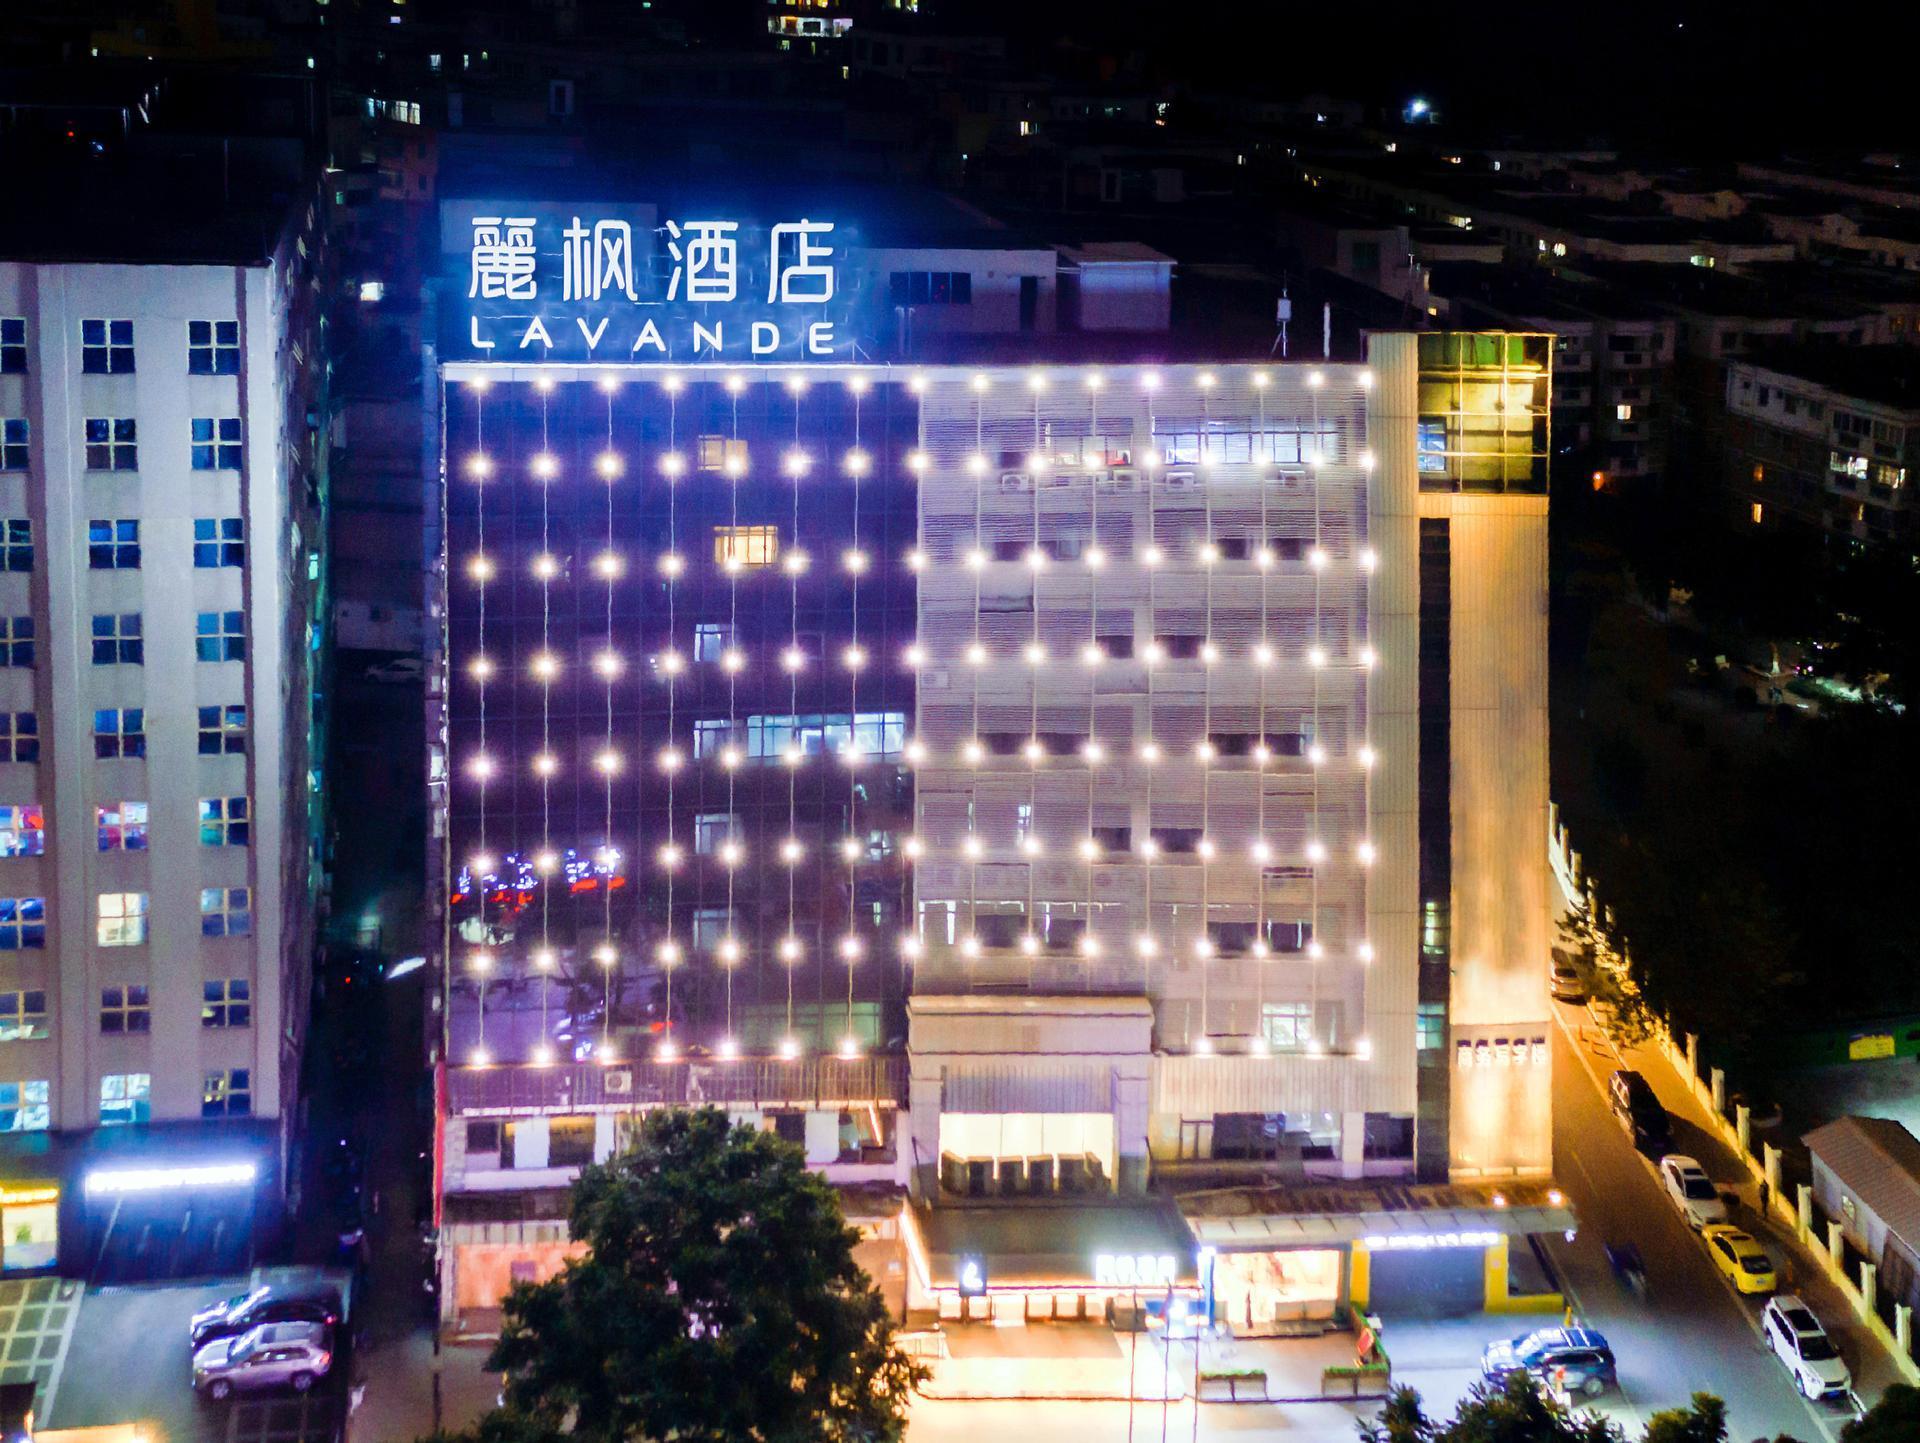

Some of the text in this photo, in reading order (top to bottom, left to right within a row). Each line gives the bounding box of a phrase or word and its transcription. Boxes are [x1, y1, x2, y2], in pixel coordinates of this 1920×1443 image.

[469, 216, 834, 304] 麗枫酒店
[471, 315, 834, 354] LAVANDE
